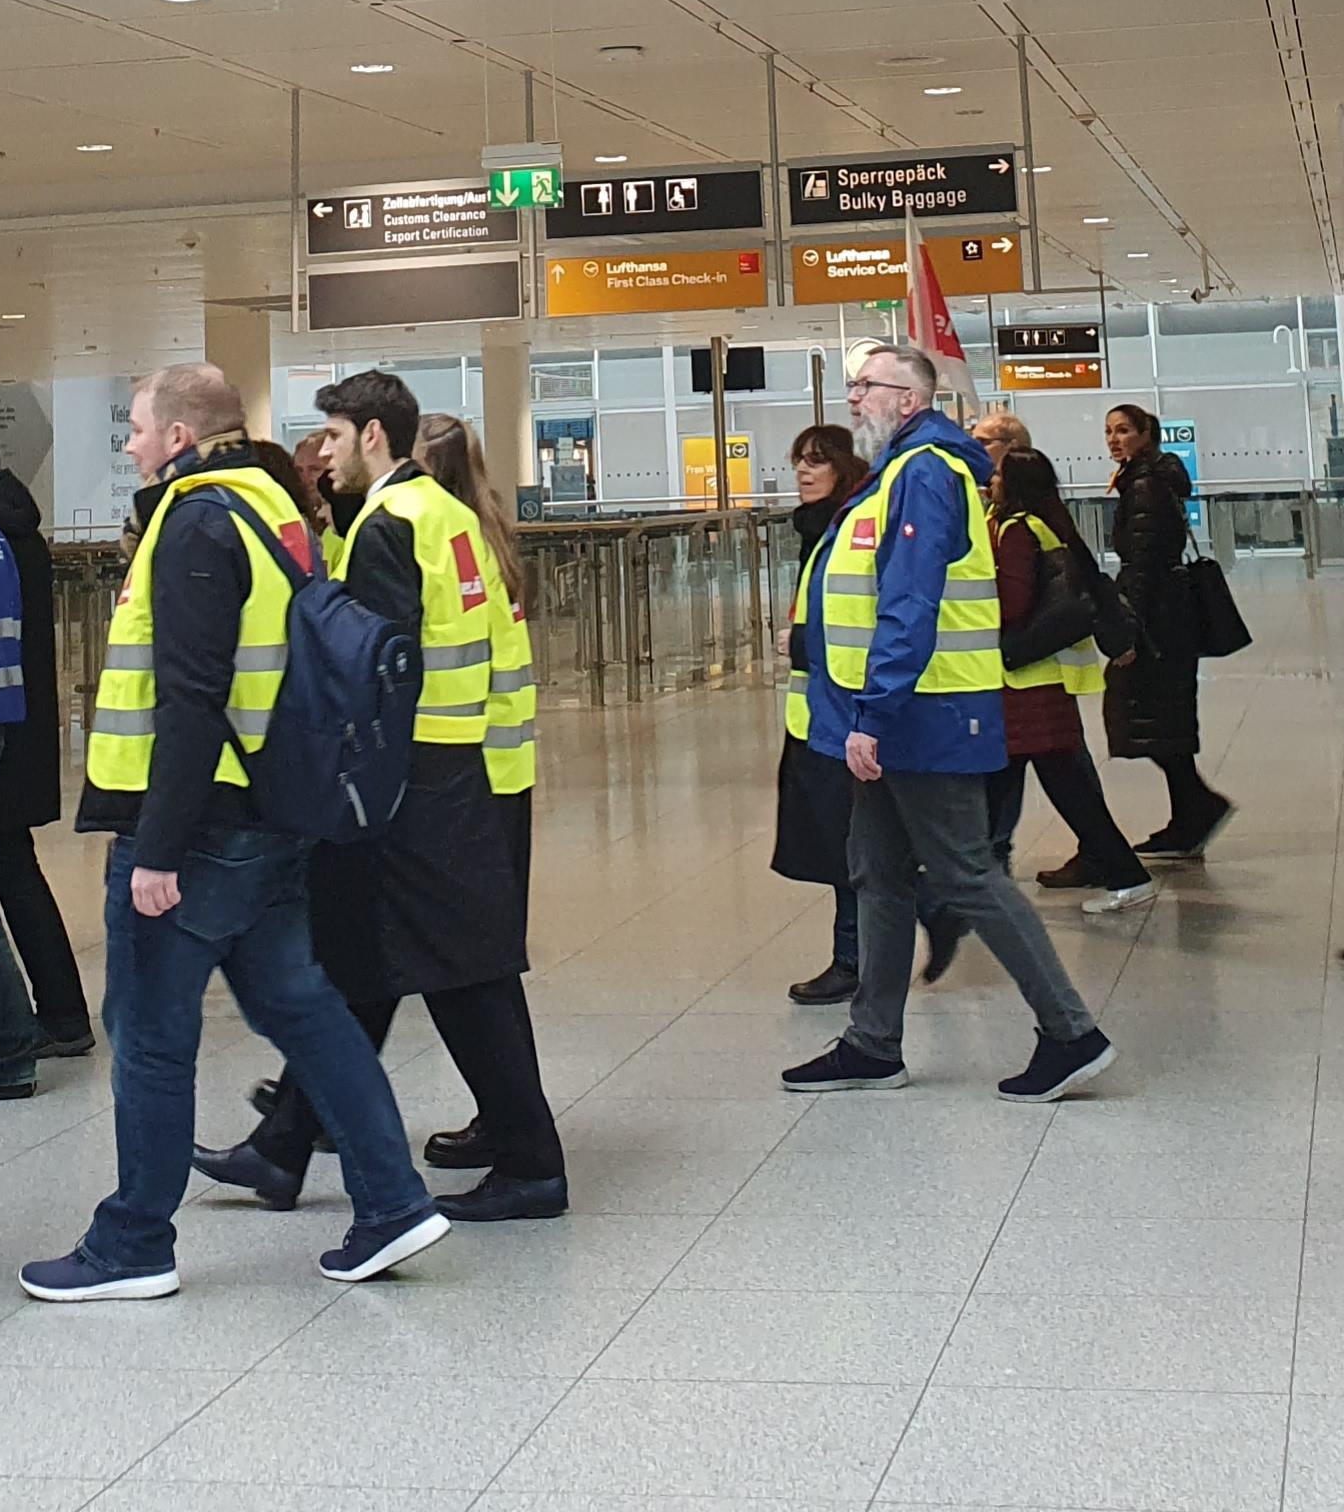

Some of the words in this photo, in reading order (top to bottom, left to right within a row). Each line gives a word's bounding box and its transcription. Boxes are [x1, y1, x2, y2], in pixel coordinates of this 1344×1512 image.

[837, 163, 946, 188] Sperrgepäck
[839, 193, 887, 211] Bulky
[892, 189, 967, 209] Baggage
[384, 212, 430, 226] Customs
[433, 209, 486, 225] Clearance
[385, 230, 420, 244] Export
[422, 226, 488, 240] Certification
[826, 249, 890, 263] Lufthansa
[606, 261, 667, 274] Lufthansa
[828, 261, 876, 278] Service
[877, 260, 909, 275] Cent
[607, 277, 634, 288] First
[636, 275, 669, 287] Class
[671, 272, 727, 285] Check-in
